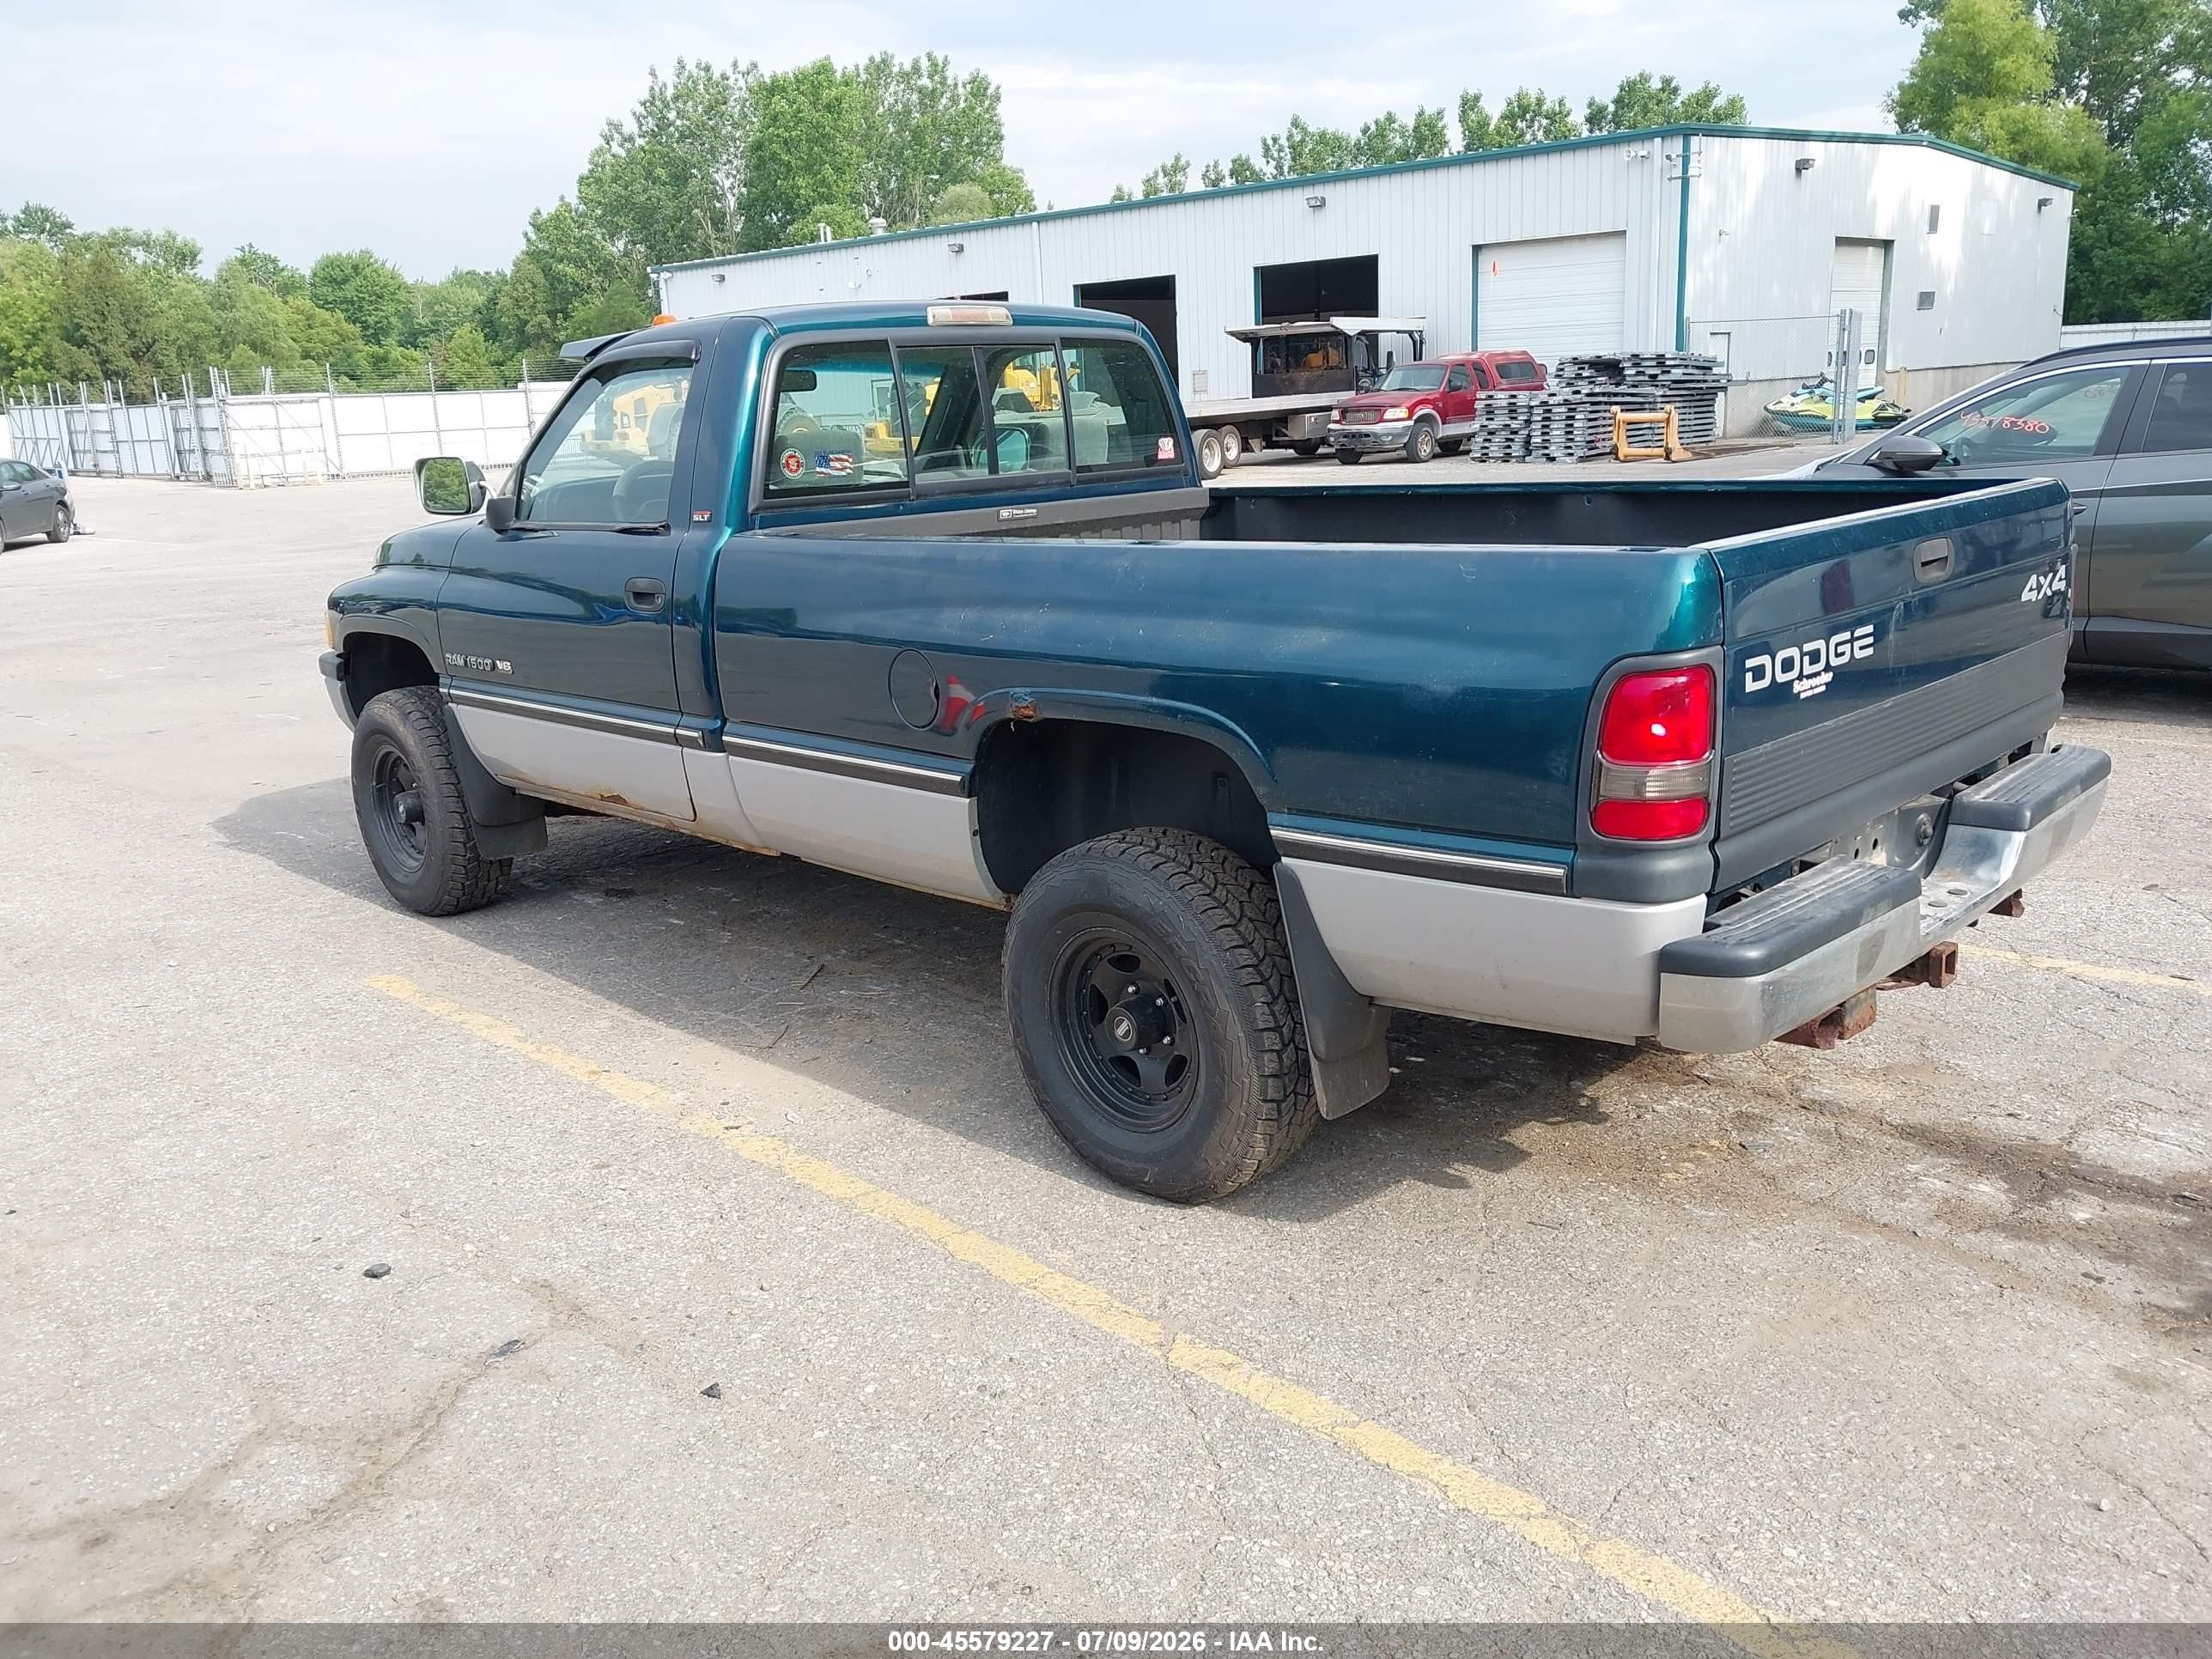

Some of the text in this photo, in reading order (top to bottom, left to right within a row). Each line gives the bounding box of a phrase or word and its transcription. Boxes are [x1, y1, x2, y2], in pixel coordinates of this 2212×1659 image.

[445, 653, 465, 667] RAM
[466, 655, 493, 672] 1500
[1745, 624, 1875, 694] DODGE
